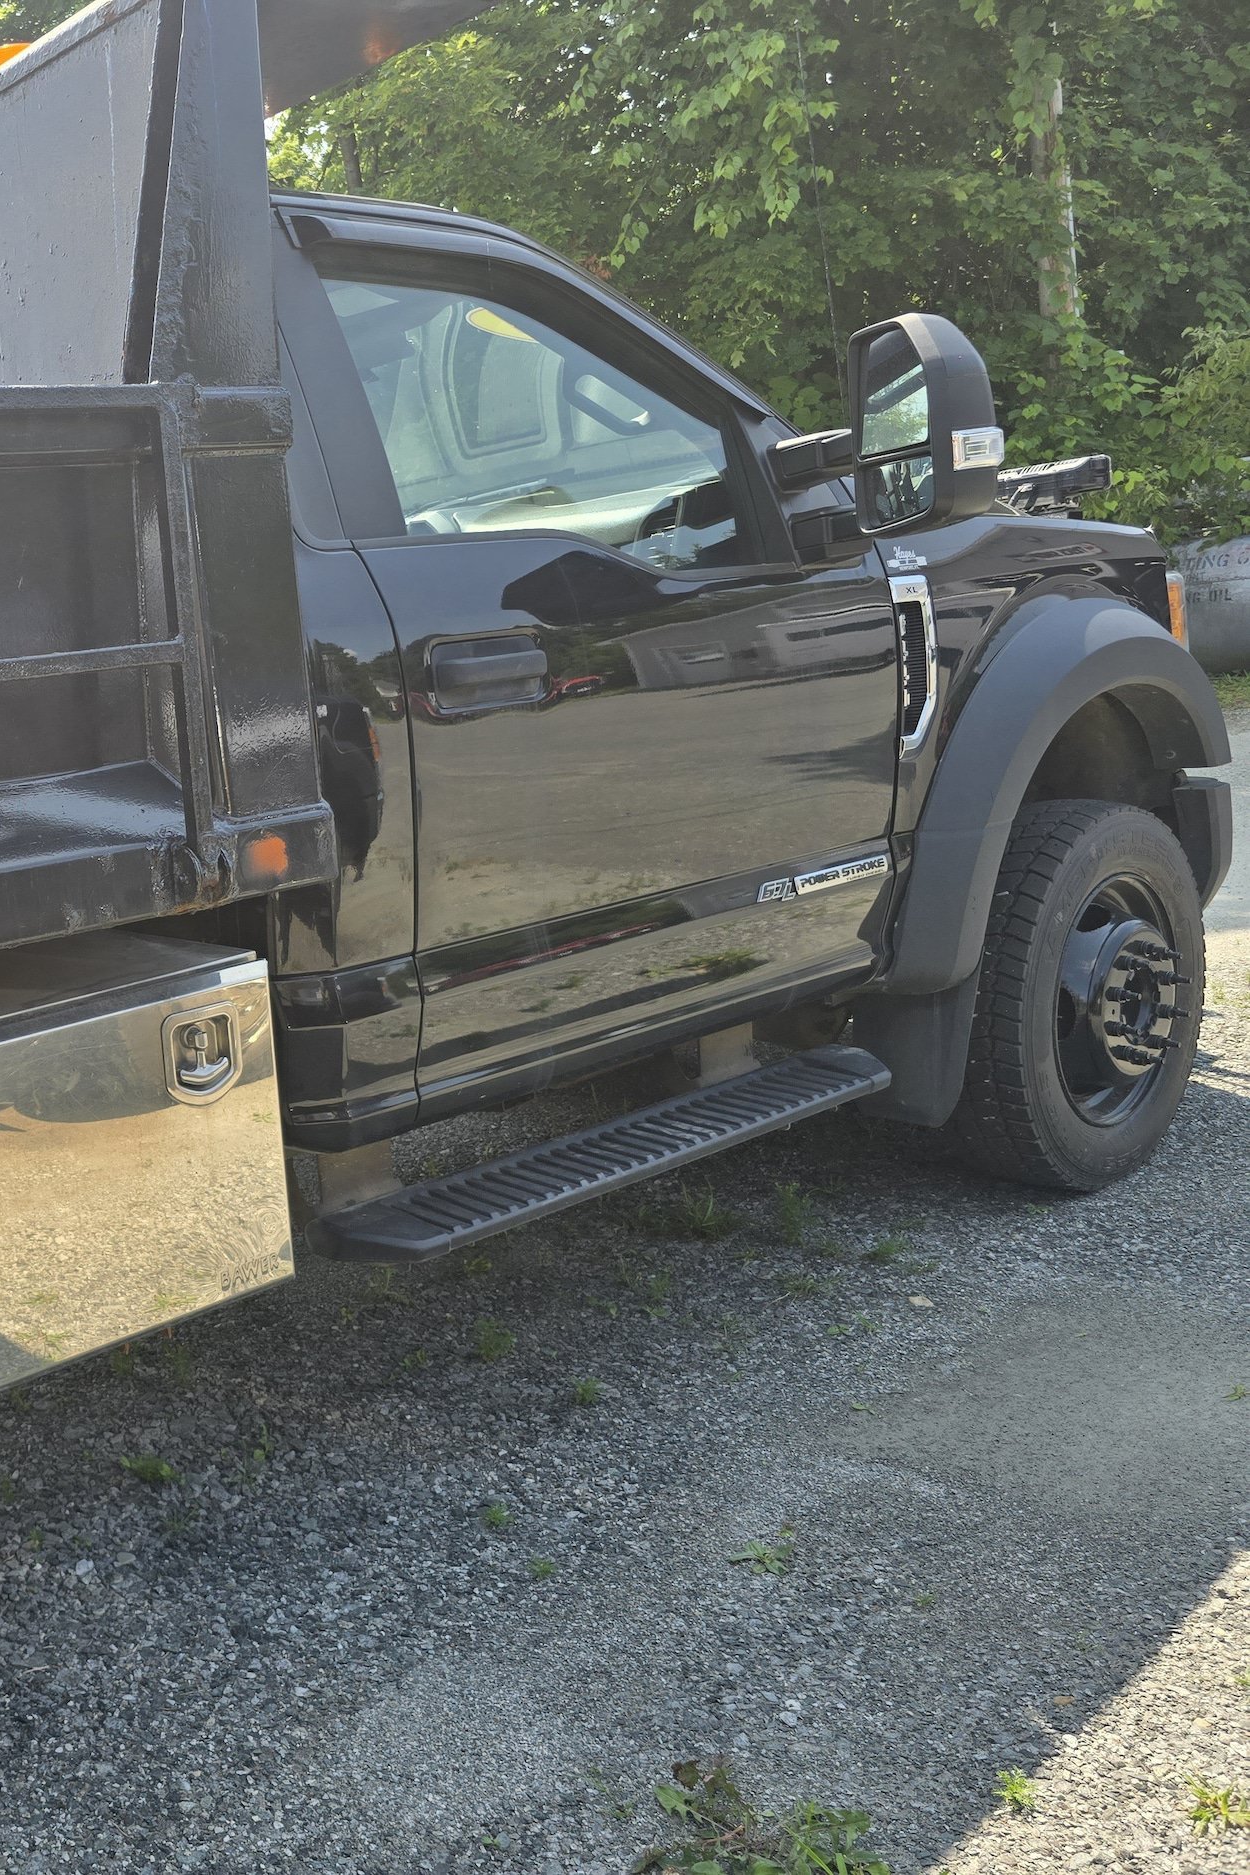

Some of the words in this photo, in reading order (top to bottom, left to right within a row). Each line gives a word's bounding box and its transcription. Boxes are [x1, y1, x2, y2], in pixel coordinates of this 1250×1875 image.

[893, 546, 916, 560] Hayes
[905, 586, 918, 594] XL
[799, 870, 840, 888] POWER
[841, 857, 885, 876] STROKE
[220, 1252, 280, 1292] BAWER
